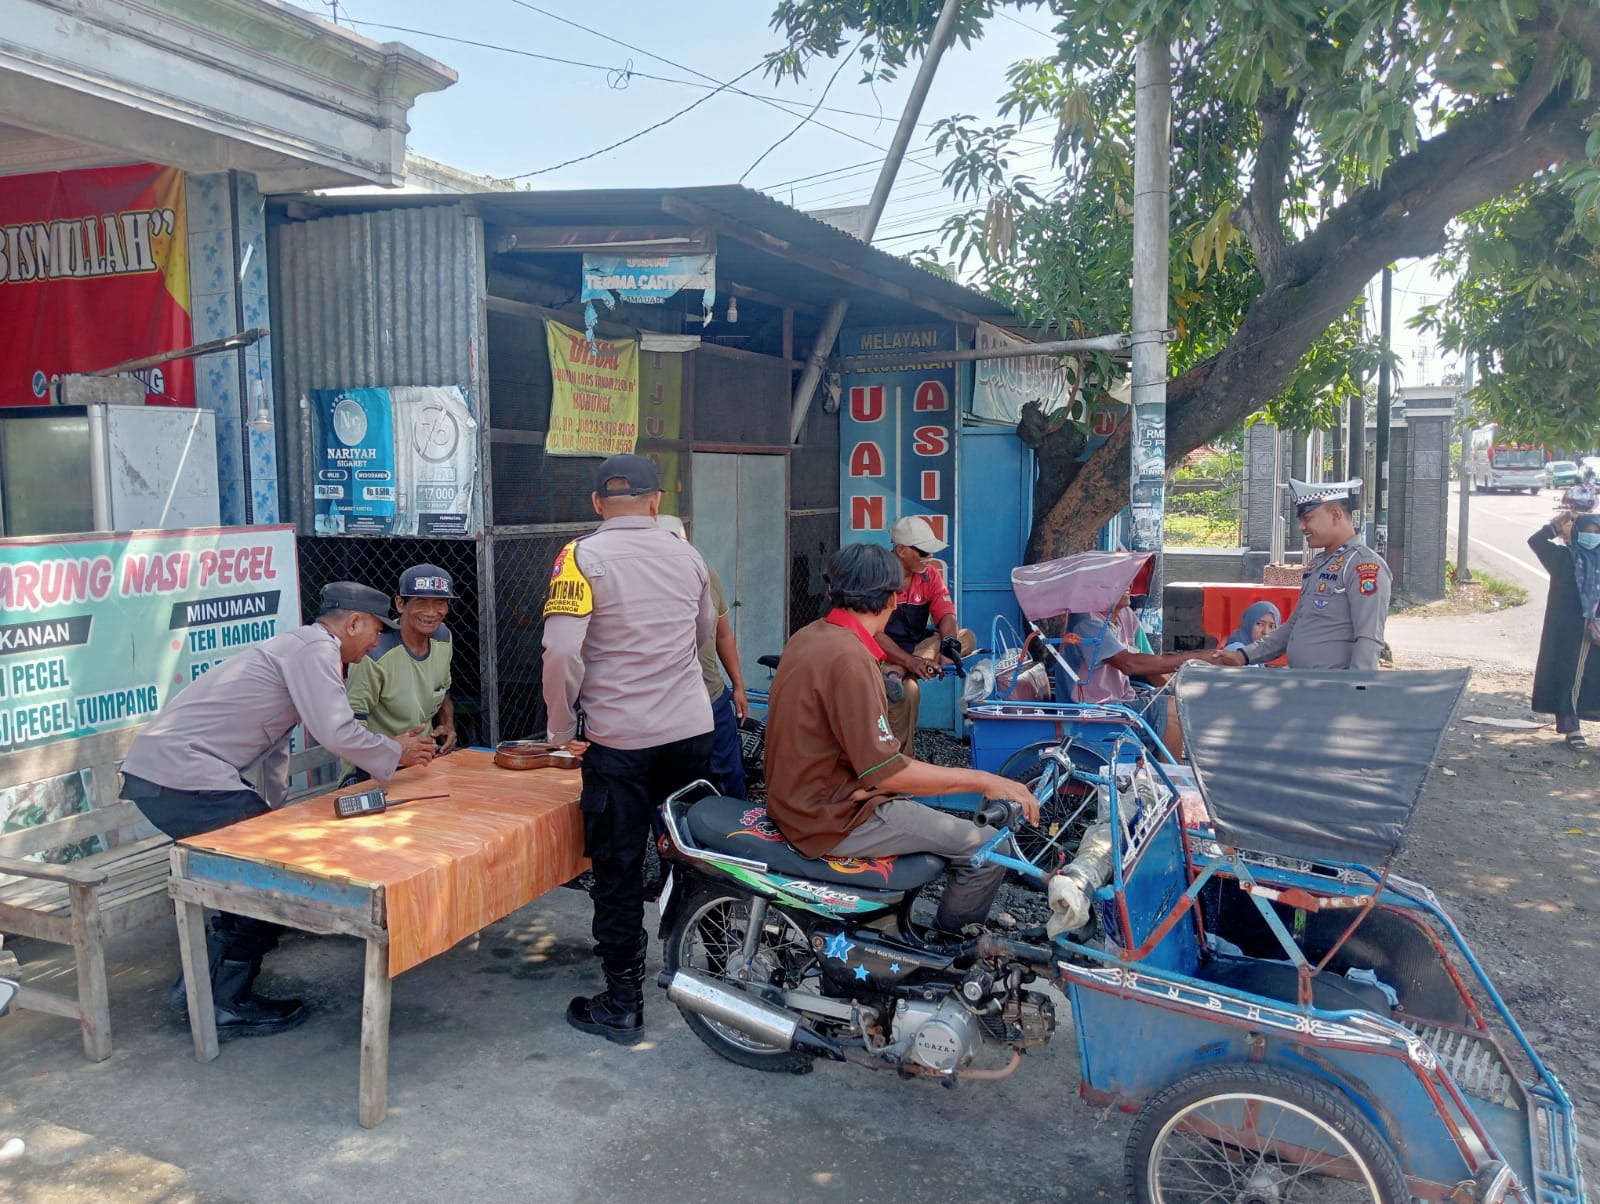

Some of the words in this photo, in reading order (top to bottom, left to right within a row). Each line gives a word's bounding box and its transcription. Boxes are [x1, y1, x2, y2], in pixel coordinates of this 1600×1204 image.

[860, 330, 937, 349] MELAYANI
[327, 448, 376, 459] NARIYAH
[122, 552, 190, 595] NASI
[200, 546, 276, 587] PECEL
[1319, 572, 1338, 581] POLRI
[187, 597, 266, 622] MINUMAN
[189, 629, 216, 652] TEH
[221, 619, 276, 648] HANGAT
[13, 659, 69, 695] PECEL
[16, 702, 72, 739] PECEL
[77, 685, 158, 726] TUMPANG
[924, 1042, 949, 1052] GAZA
